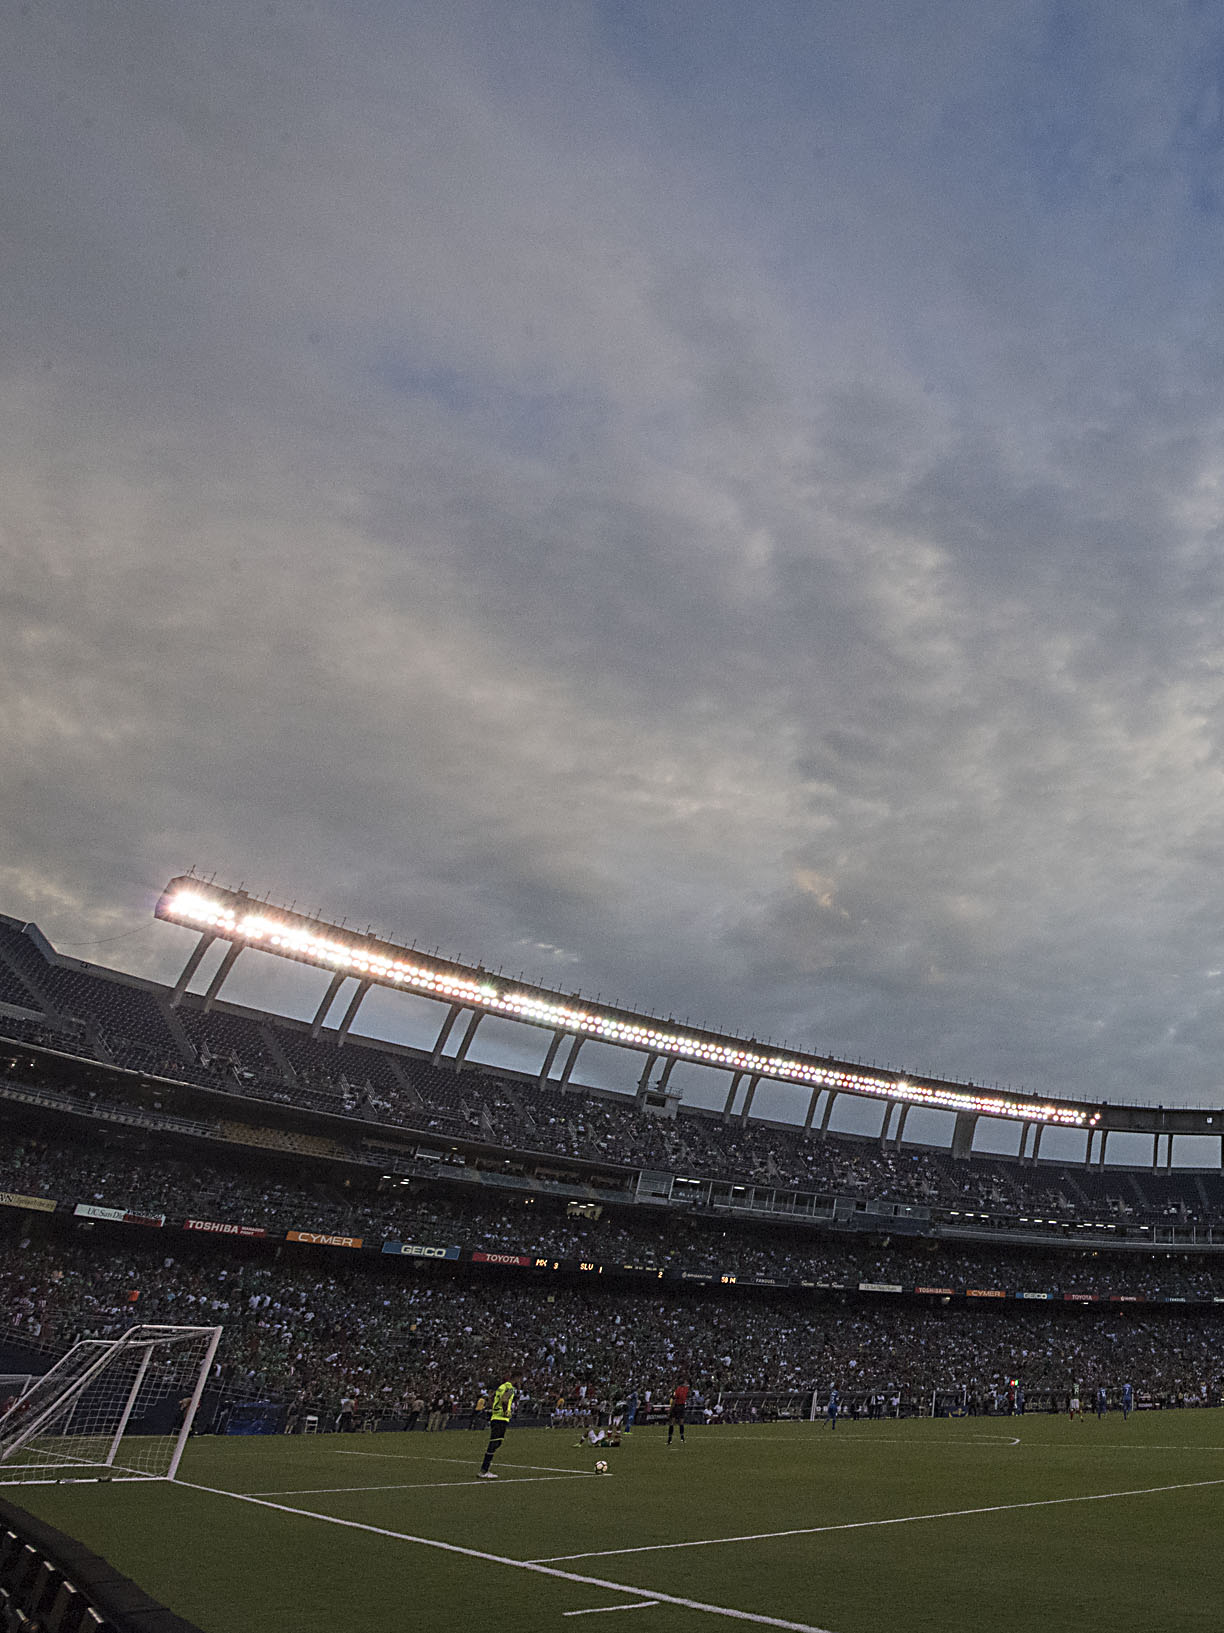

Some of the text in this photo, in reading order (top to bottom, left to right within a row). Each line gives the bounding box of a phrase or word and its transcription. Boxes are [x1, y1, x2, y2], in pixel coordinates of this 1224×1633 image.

[188, 1220, 239, 1234] TOSHIBA
[298, 1232, 353, 1247] CYMER
[401, 1245, 446, 1258] GEICO
[486, 1253, 520, 1264] TOYOTA
